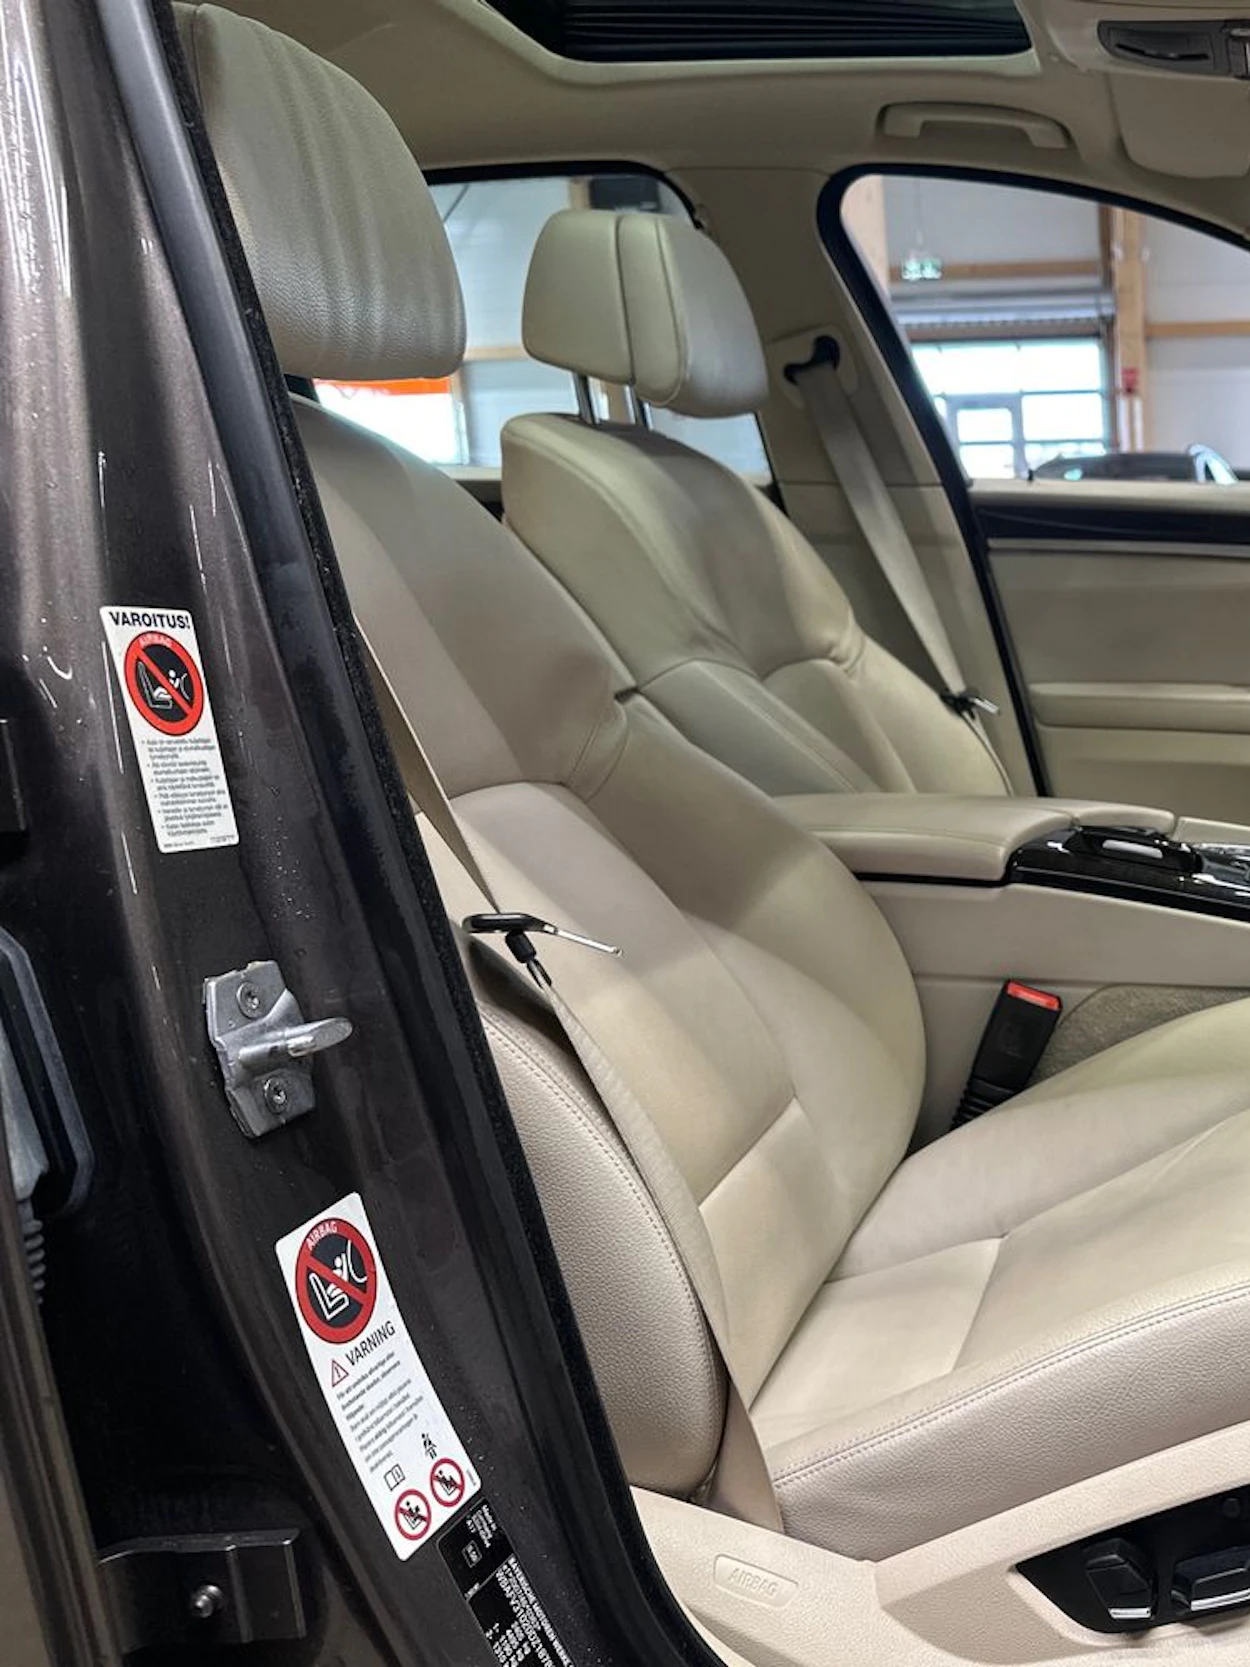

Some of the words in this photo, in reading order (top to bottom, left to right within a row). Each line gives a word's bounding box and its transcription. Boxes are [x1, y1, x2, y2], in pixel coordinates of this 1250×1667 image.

[108, 611, 190, 629] VAROITUS!
[307, 1221, 338, 1251] AIRBAG
[345, 1320, 395, 1366] VARNING
[728, 1568, 779, 1597] AIRBAG
[532, 1601, 556, 1641] MOTOREN
